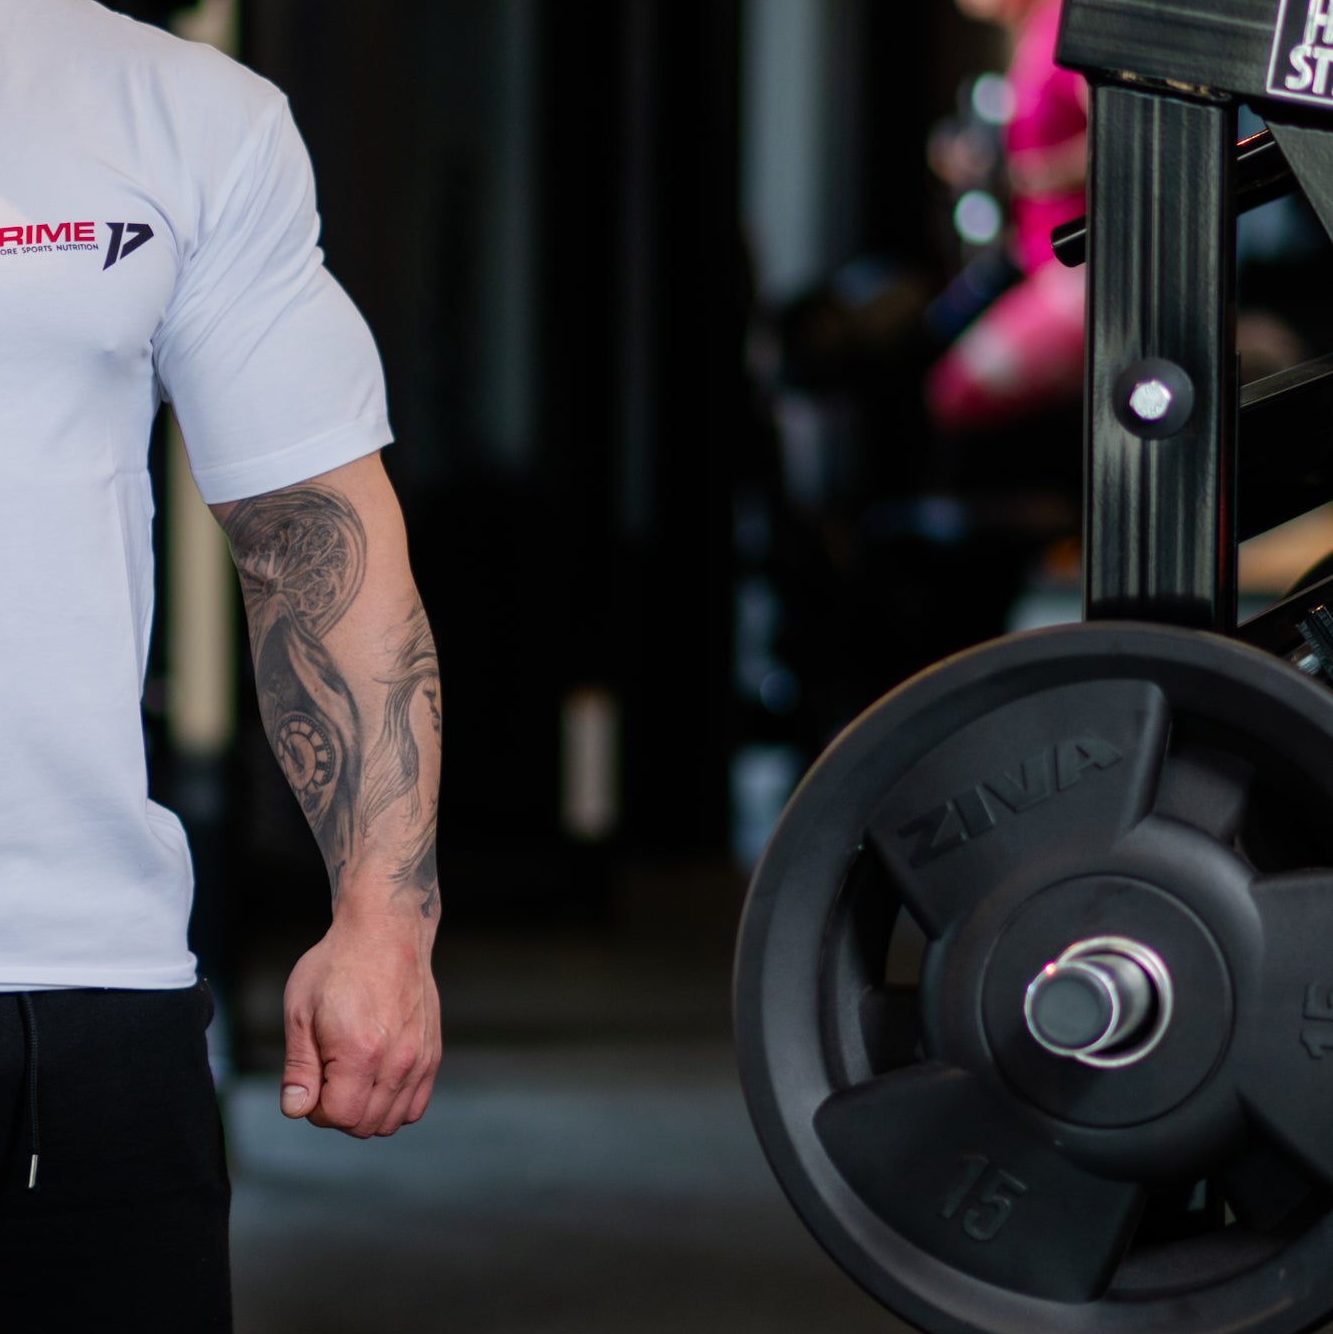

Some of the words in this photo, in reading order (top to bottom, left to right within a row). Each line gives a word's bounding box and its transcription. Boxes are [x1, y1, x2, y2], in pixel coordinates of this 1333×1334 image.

[1284, 44, 1333, 95] ST
[22, 245, 53, 254] SPORTS
[56, 243, 99, 252] NUTRITION
[897, 729, 1123, 869] ZIVA
[939, 1153, 1027, 1241] 15
